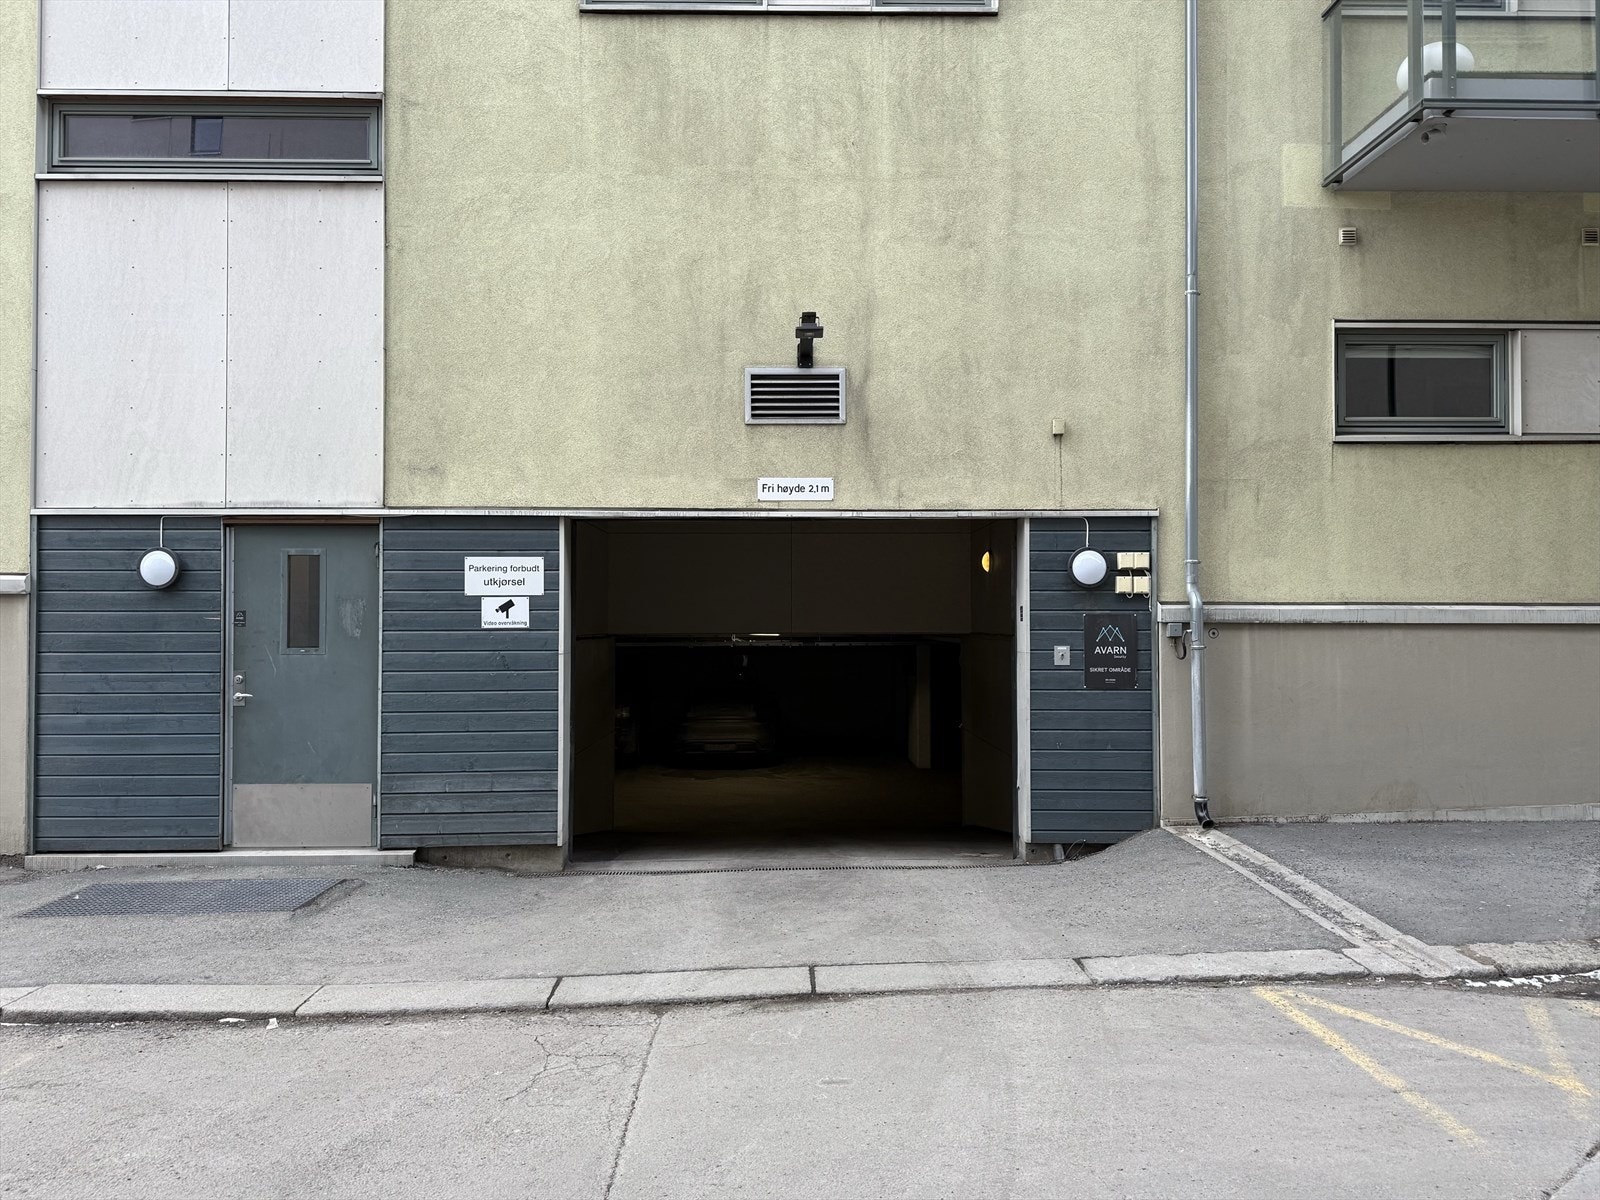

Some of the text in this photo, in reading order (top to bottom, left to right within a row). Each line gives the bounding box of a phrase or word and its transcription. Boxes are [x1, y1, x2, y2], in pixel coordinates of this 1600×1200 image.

[761, 483, 775, 493] Fri
[777, 483, 806, 496] høyde
[468, 564, 540, 574] Parkering forbudt
[483, 577, 526, 588] utkjørsel
[1094, 646, 1127, 655] AVARN
